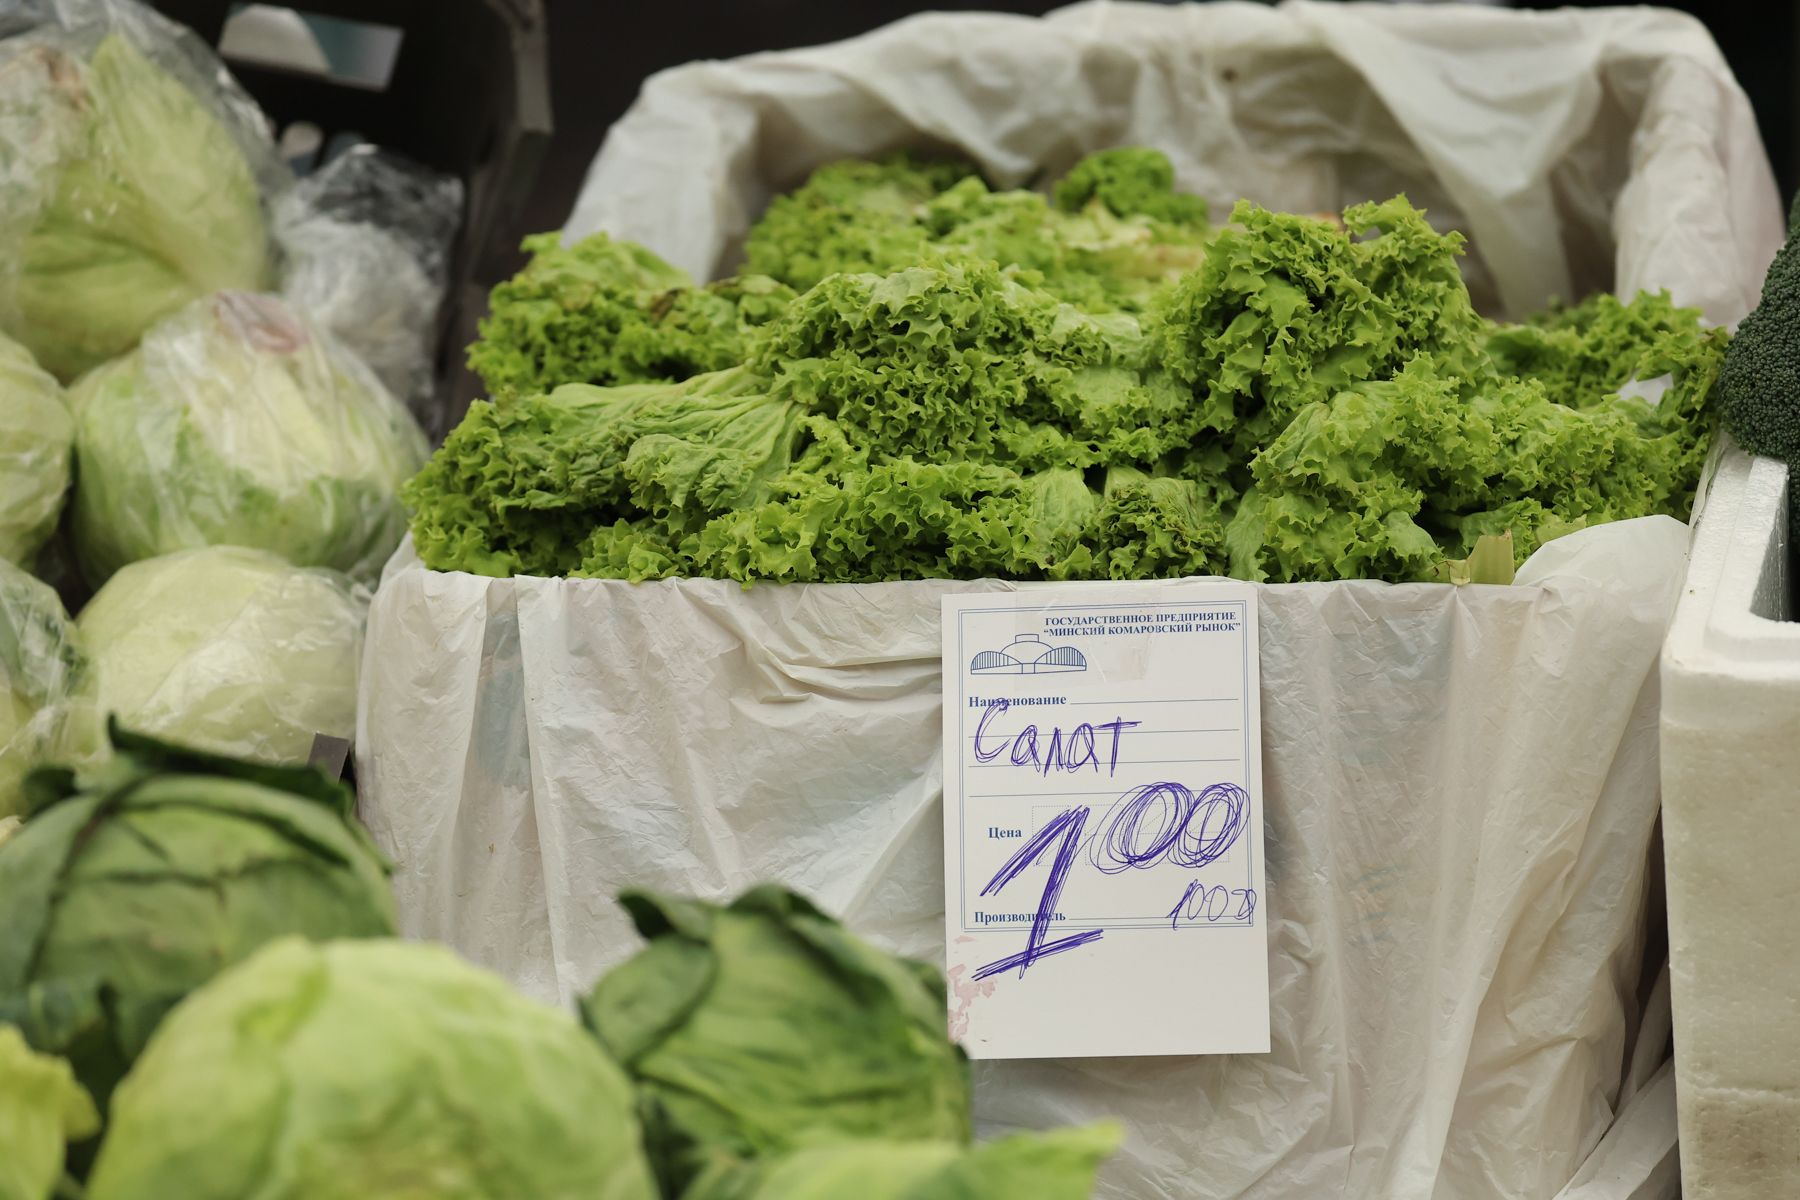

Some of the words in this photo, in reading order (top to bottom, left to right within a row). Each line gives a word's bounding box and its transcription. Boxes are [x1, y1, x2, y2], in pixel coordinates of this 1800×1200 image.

[1045, 614, 1153, 626] ГОСУДАРСТВЕННОЕ
[1156, 611, 1236, 623] ПРЕДПРИЯТИЕ
[1108, 622, 1193, 635] КОМАРОВСКИЙ
[968, 695, 1067, 708] Наиенование
[974, 697, 1142, 778] Салат
[988, 826, 1022, 840] Цена
[974, 911, 1066, 925] Производиль
